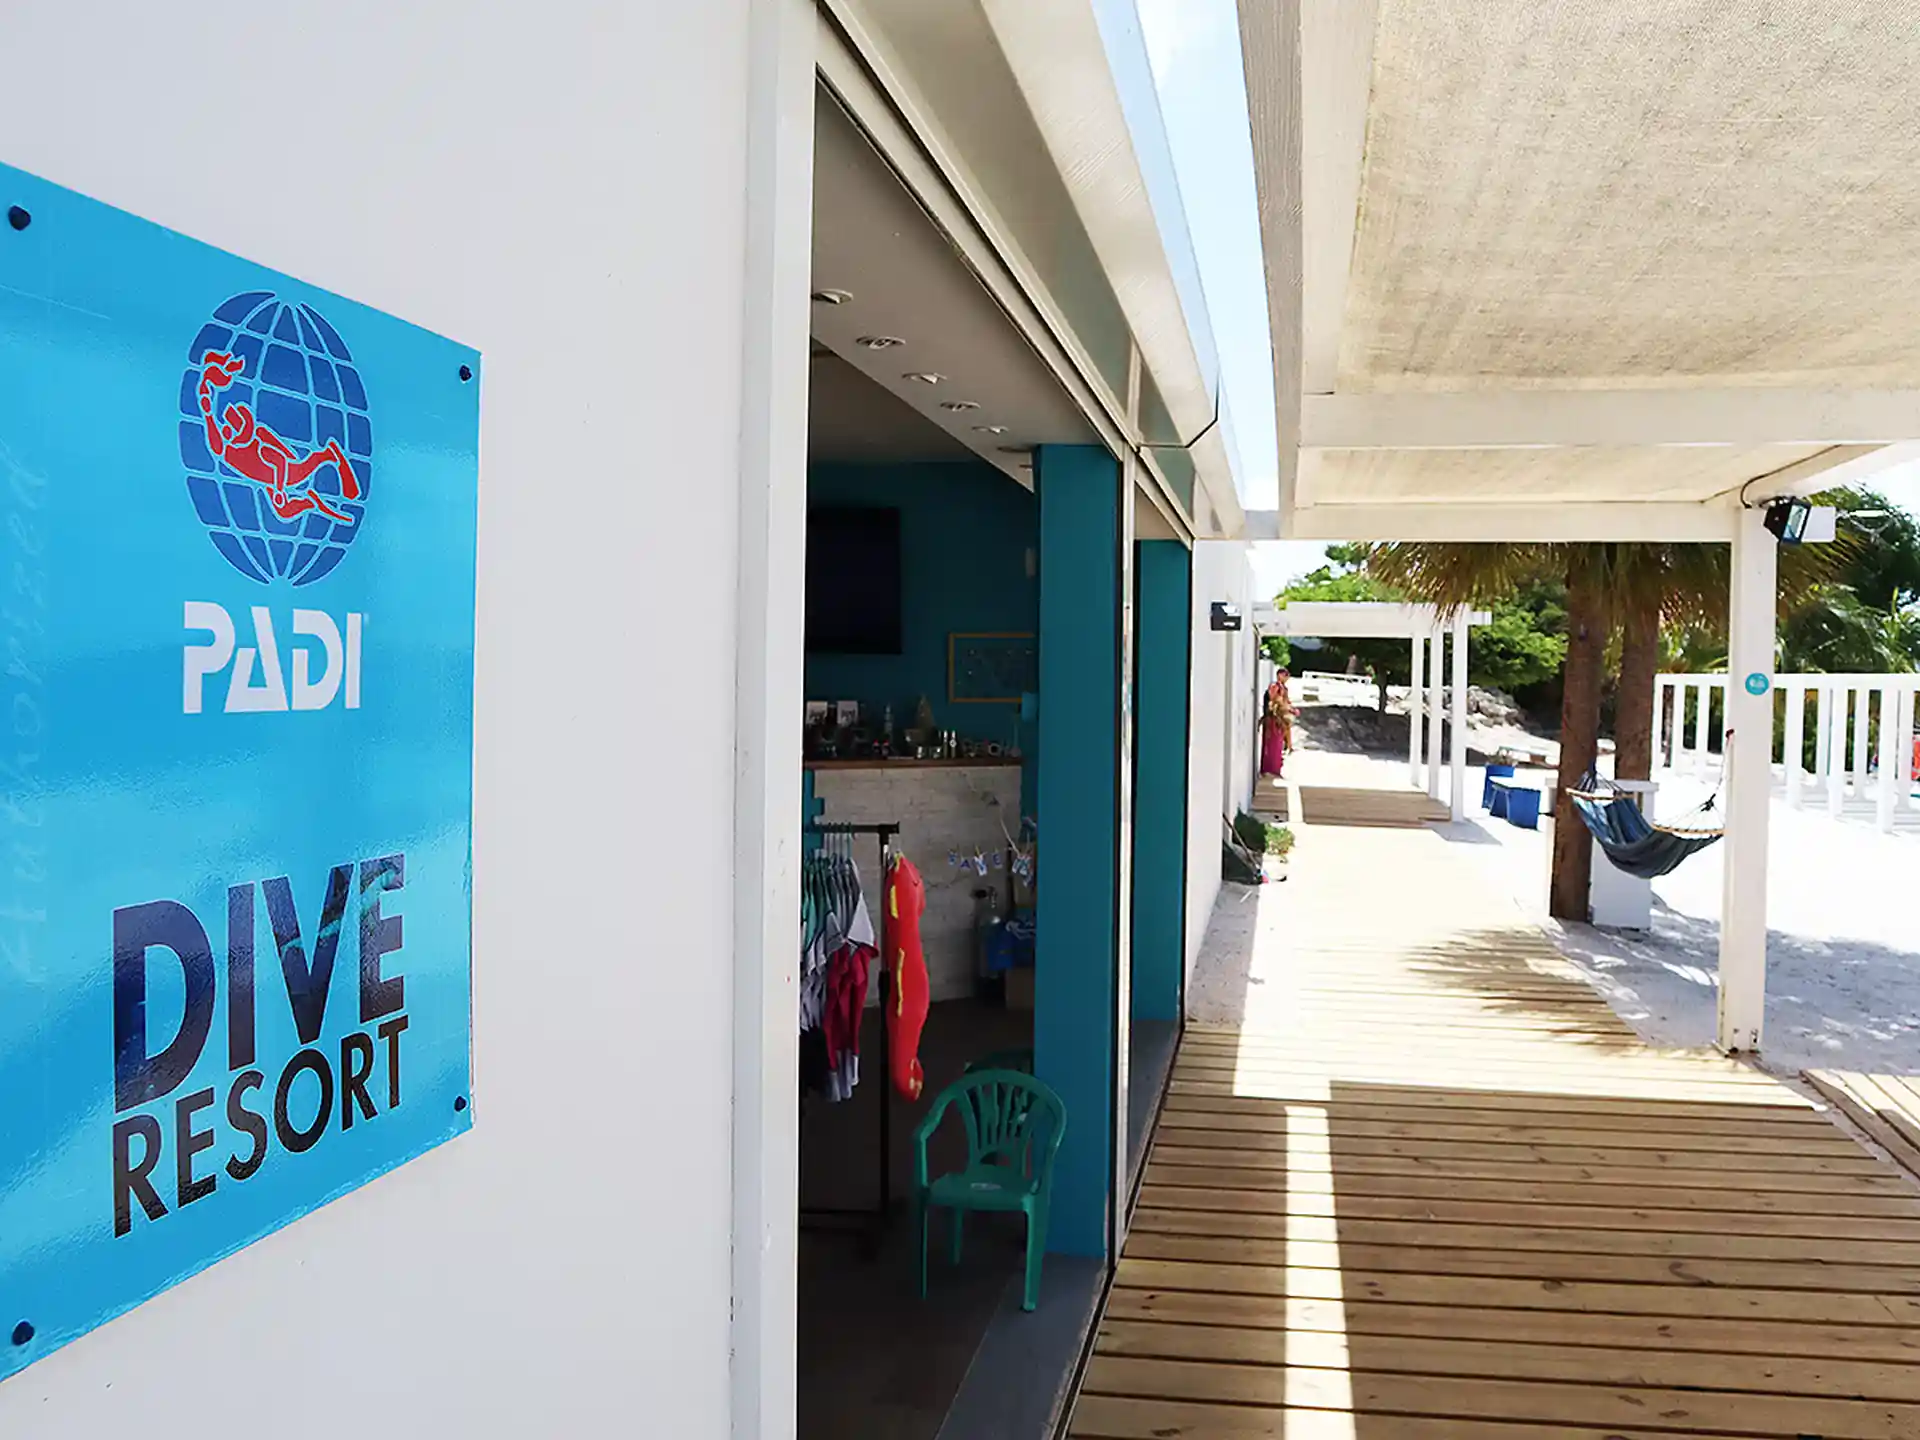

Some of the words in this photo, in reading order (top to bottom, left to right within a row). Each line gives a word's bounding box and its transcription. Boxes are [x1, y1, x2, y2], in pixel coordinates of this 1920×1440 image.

[182, 600, 362, 714] PADI
[113, 853, 405, 1113] DIVE
[113, 1015, 408, 1239] RESORT
